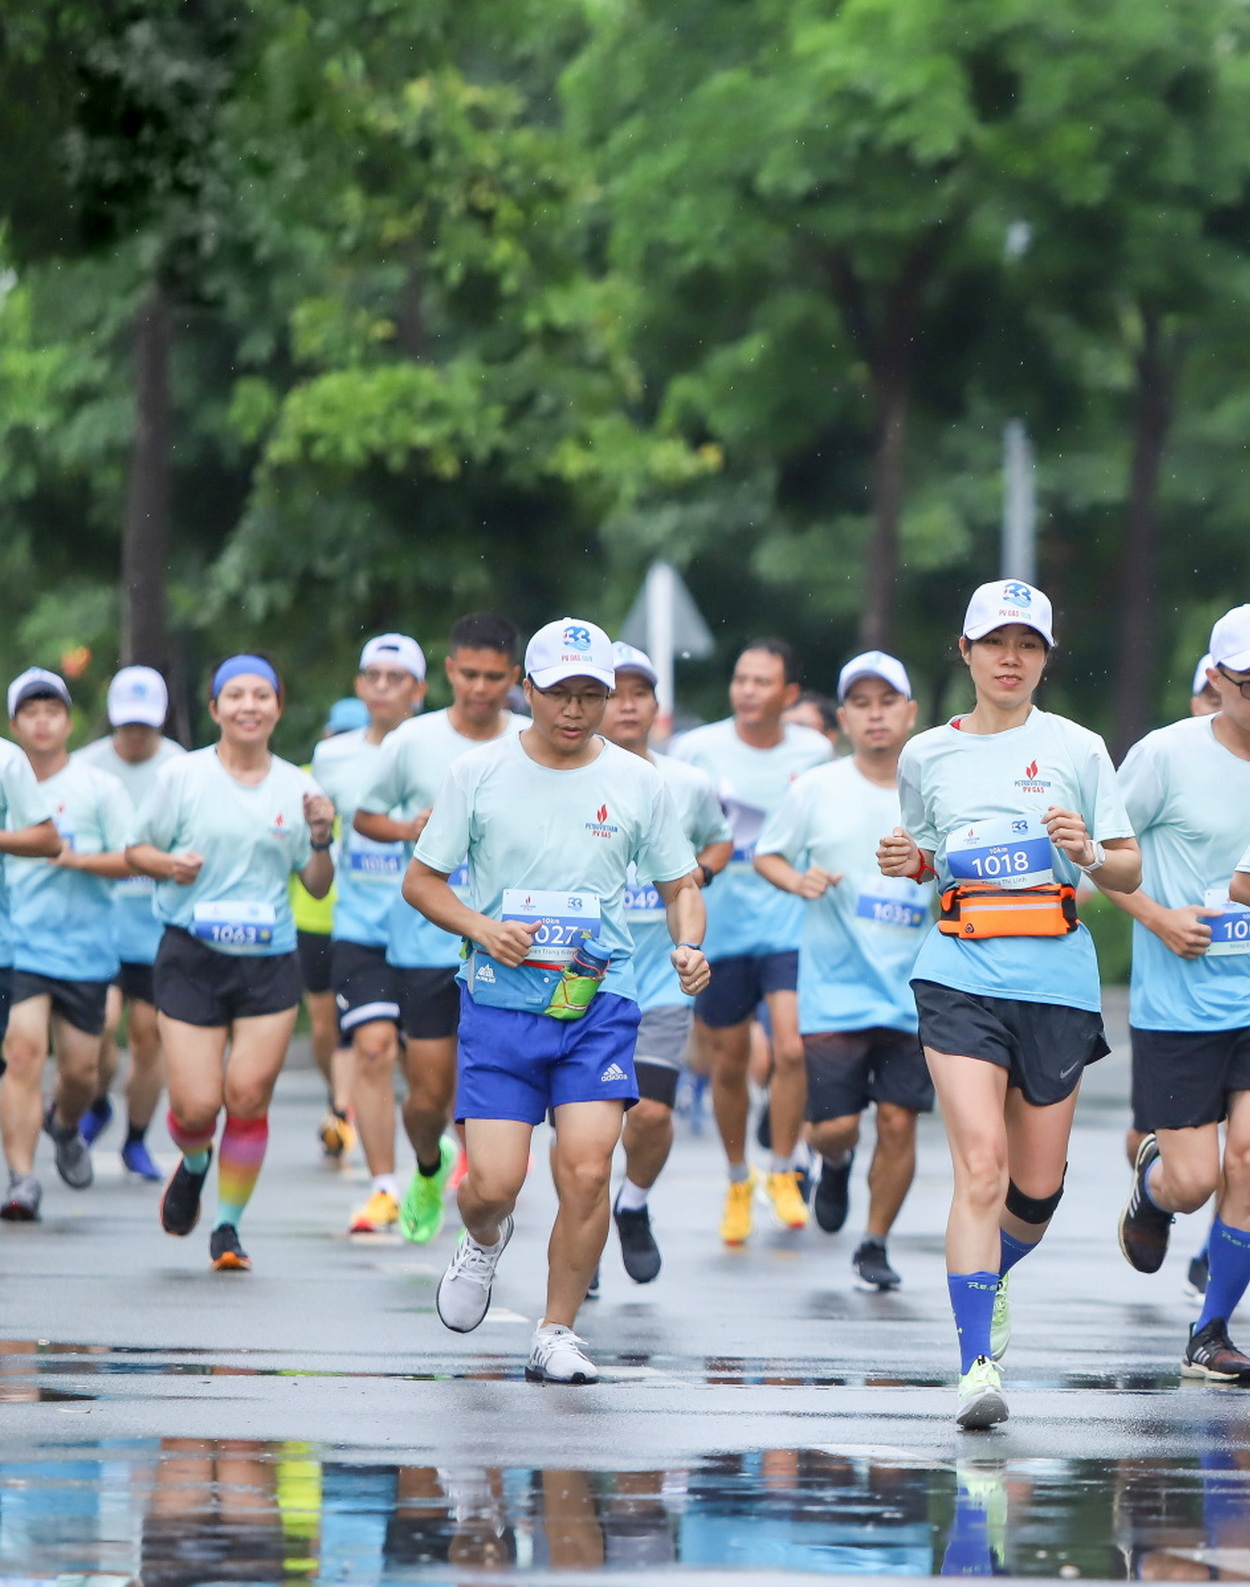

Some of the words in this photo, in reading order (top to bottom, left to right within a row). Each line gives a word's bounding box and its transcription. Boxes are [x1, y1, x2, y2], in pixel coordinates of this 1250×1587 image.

[972, 851, 1029, 877] 1018
[623, 890, 659, 909] 049
[212, 924, 257, 944] 1063
[534, 924, 579, 945] 027
[601, 1073, 628, 1081] adidas
